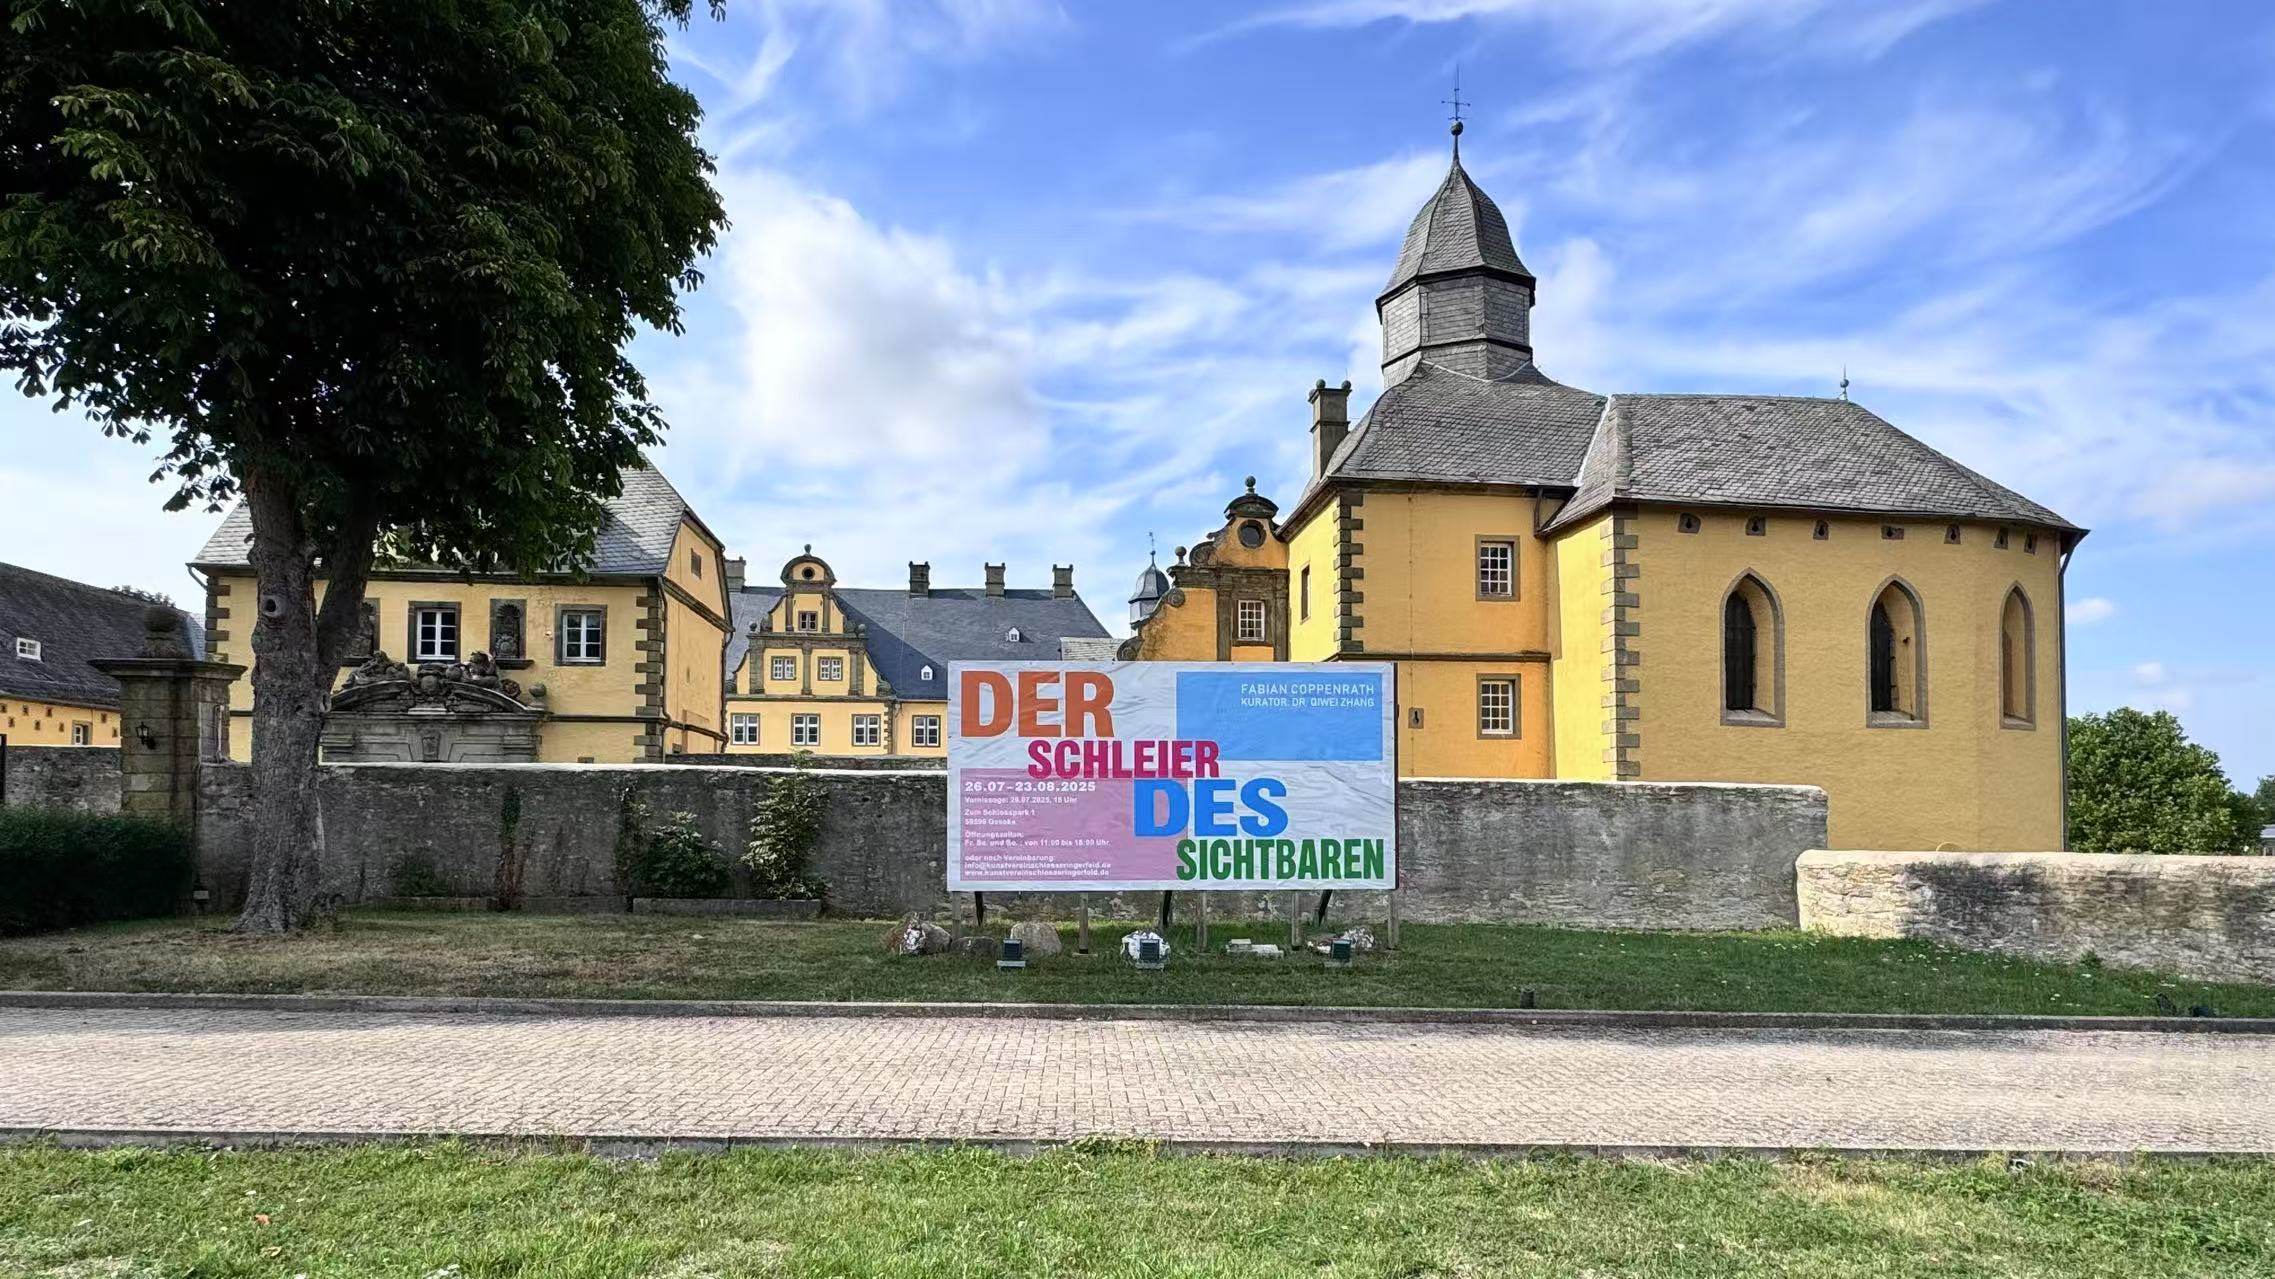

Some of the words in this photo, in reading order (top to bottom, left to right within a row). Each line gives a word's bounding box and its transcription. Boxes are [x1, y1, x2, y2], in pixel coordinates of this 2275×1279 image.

[1241, 684, 1286, 694] FABIAN
[1291, 684, 1374, 695] COPPENRATH
[961, 670, 1115, 738] DER
[1311, 698, 1339, 707] QIWEI
[1340, 698, 1375, 707] ZHANG
[1028, 740, 1220, 779] SCHLEIER
[1064, 796, 1078, 804] Uhr
[1134, 777, 1287, 837] DES
[964, 808, 981, 816] Zum
[983, 808, 1030, 818] Schlosspark
[989, 839, 1004, 847] und
[1061, 839, 1073, 847] bis
[1176, 838, 1384, 881] SICHTBAREN
